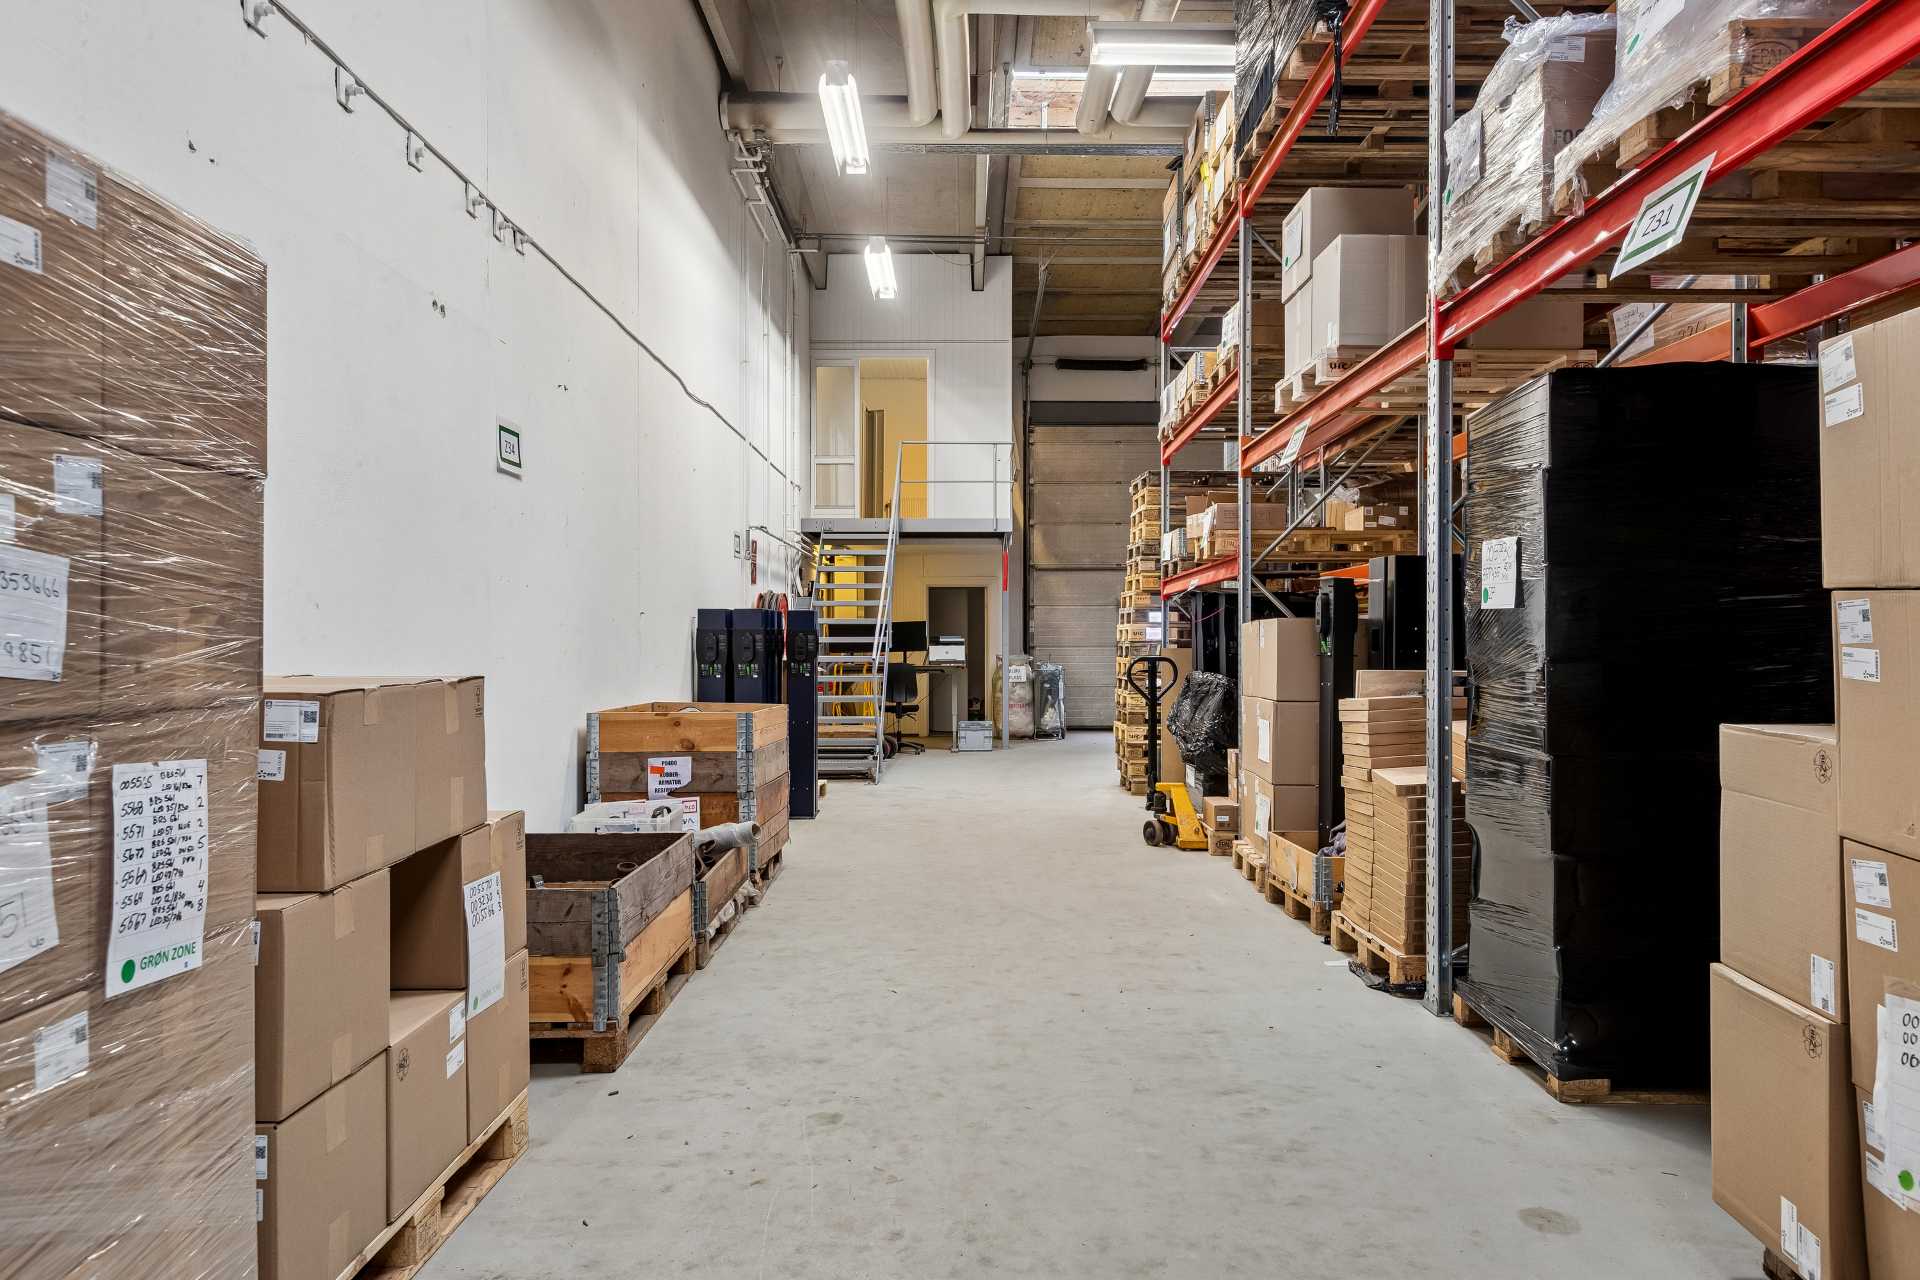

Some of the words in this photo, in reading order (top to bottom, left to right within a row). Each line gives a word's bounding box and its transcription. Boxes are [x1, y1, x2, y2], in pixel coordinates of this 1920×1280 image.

[1641, 203, 1674, 238] Z31
[196, 796, 204, 808] 2
[197, 834, 206, 849] 5
[139, 950, 170, 971] GRØN
[171, 941, 197, 961] ZONE
